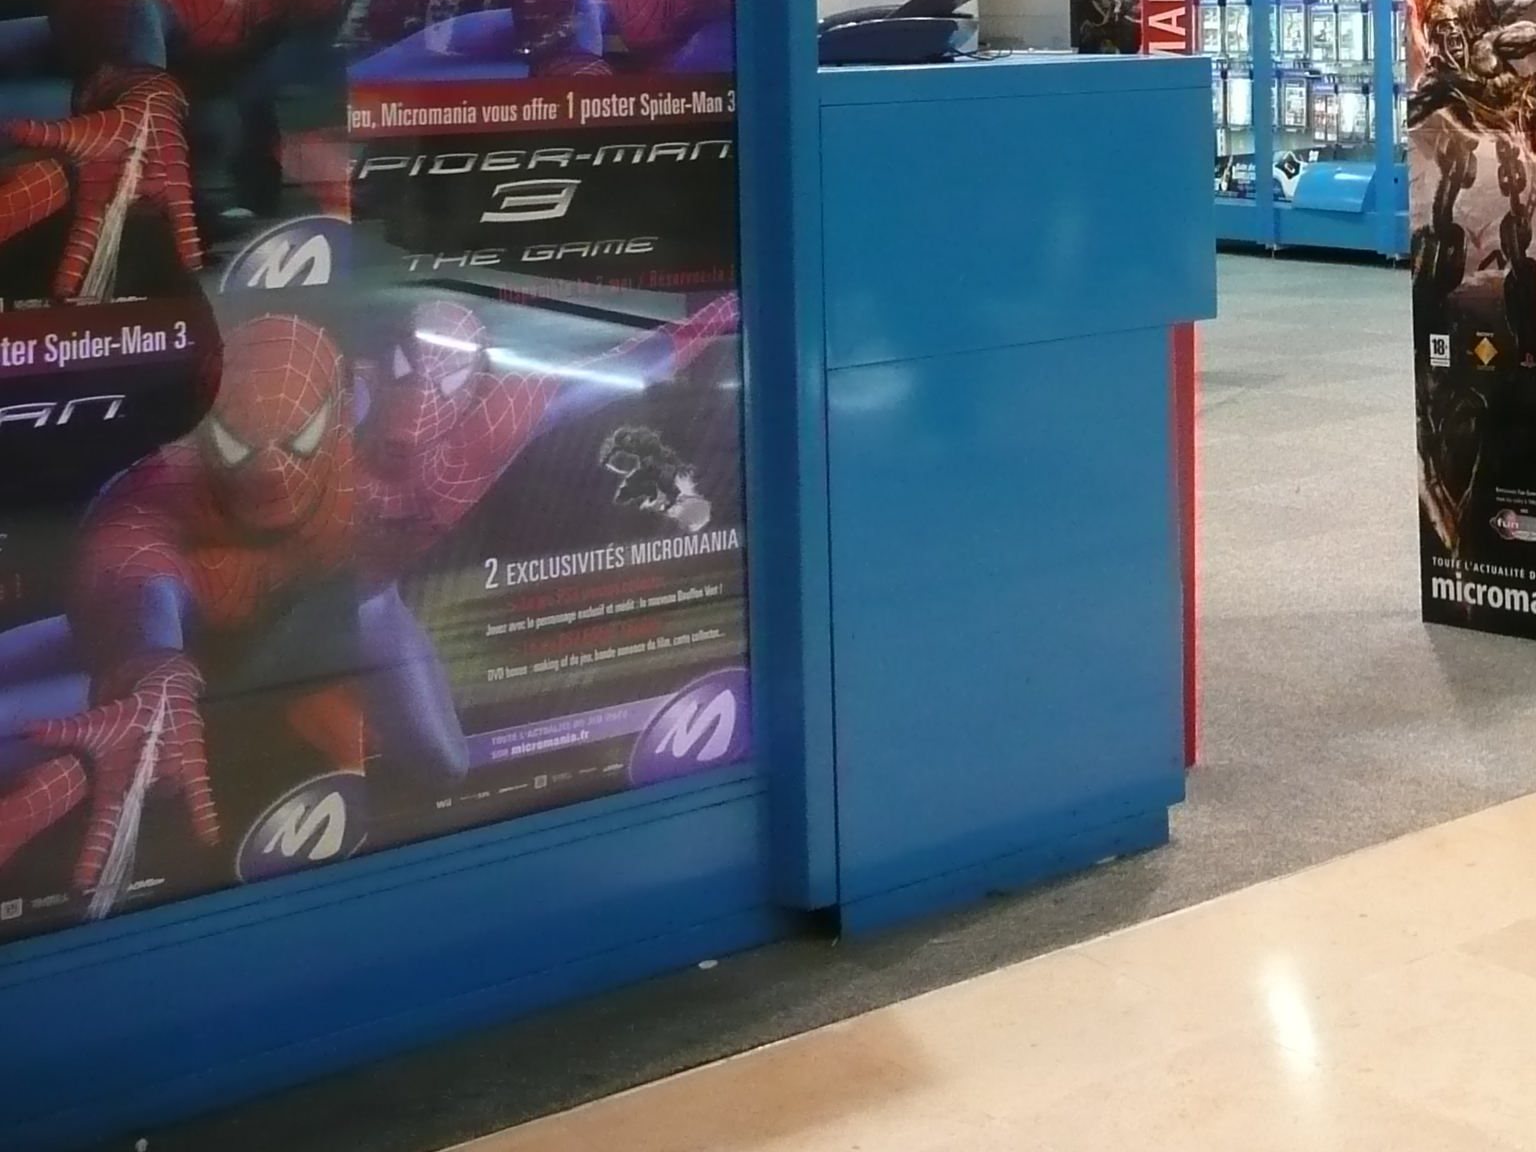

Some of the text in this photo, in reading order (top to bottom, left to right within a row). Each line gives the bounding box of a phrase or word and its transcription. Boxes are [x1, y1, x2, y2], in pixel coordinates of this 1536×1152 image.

[381, 100, 477, 128] Micromania
[482, 105, 517, 123] vous
[522, 100, 558, 122] offre
[566, 91, 575, 118] 1
[580, 94, 636, 124] poster
[640, 91, 722, 121] Spider-Man
[727, 93, 736, 114] 3
[349, 140, 733, 179] PIDER-MAN
[480, 178, 582, 223] 3
[401, 236, 660, 271] THE GAME
[44, 324, 166, 367] Spider-Man
[174, 321, 187, 350] 3
[1497, 517, 1519, 529] fun
[484, 528, 739, 590] 2 EXCLUSIVITÉS MICROMANIA
[1432, 556, 1461, 570] TOUTE
[1464, 561, 1525, 579] L'ACTUALITÉ
[511, 730, 590, 757] micromania.fr
